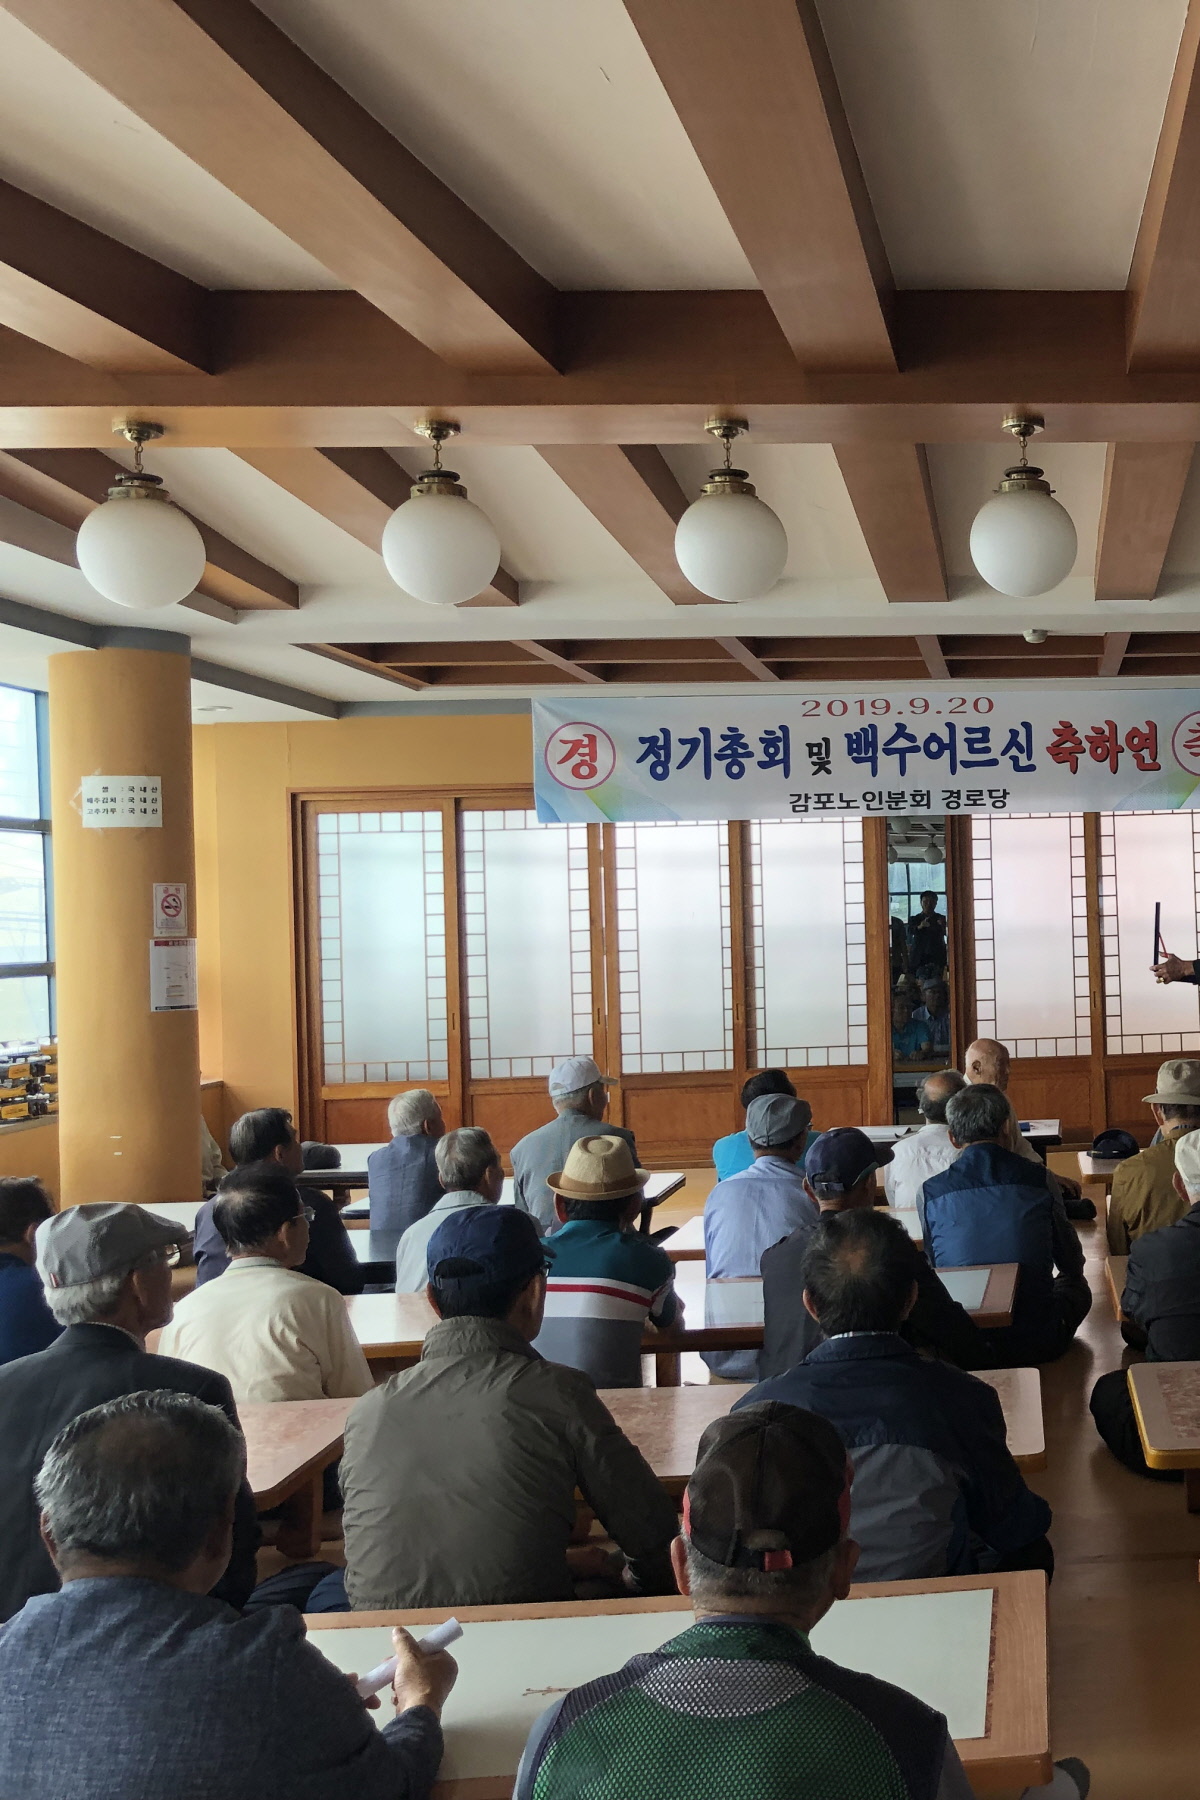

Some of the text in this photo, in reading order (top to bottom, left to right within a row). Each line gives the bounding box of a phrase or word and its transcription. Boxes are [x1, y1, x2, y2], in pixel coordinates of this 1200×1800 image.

[801, 697, 995, 718] 2019.9.20
[556, 733, 598, 780] 경
[636, 727, 791, 781] 정기총회
[805, 737, 832, 776] 및
[844, 721, 1037, 778] 백수어르신
[1046, 719, 1162, 775] 축하연
[789, 788, 1010, 813] 감포노인분회 경로당
